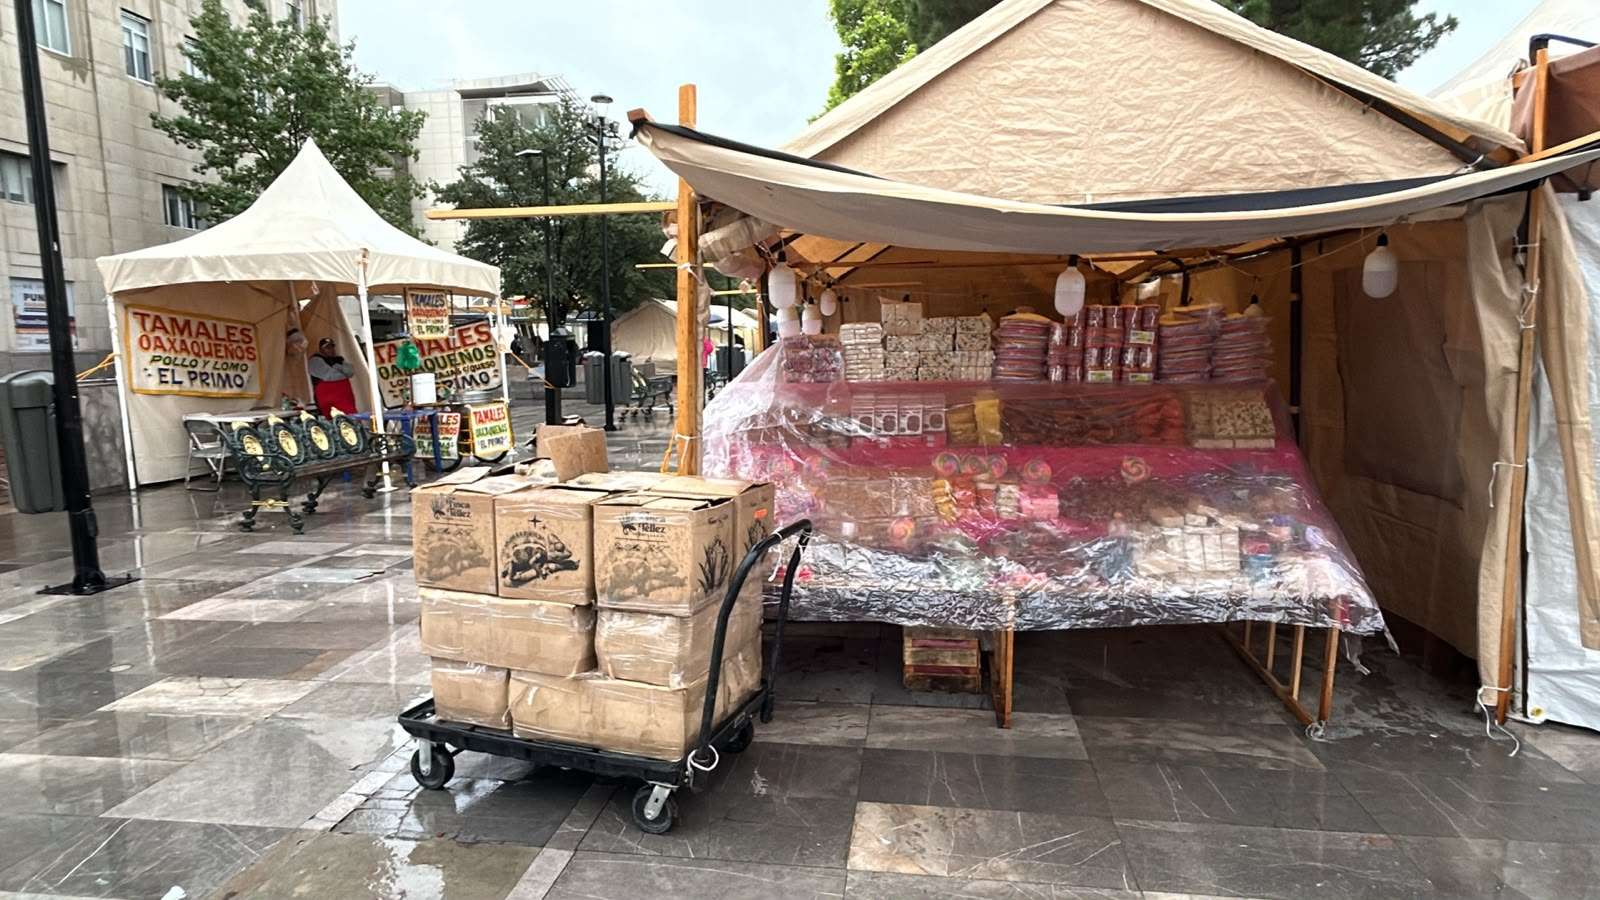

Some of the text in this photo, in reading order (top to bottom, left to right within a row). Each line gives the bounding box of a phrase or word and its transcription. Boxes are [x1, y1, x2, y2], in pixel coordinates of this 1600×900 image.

[411, 293, 446, 308] TAMALES
[133, 311, 254, 345] TAMALES
[138, 334, 257, 361] OAXAQUEÑOS
[150, 355, 249, 373] POLLO Y LOMO
[378, 344, 497, 380] OAQUEÑOS
[473, 407, 506, 424] TAMALES
